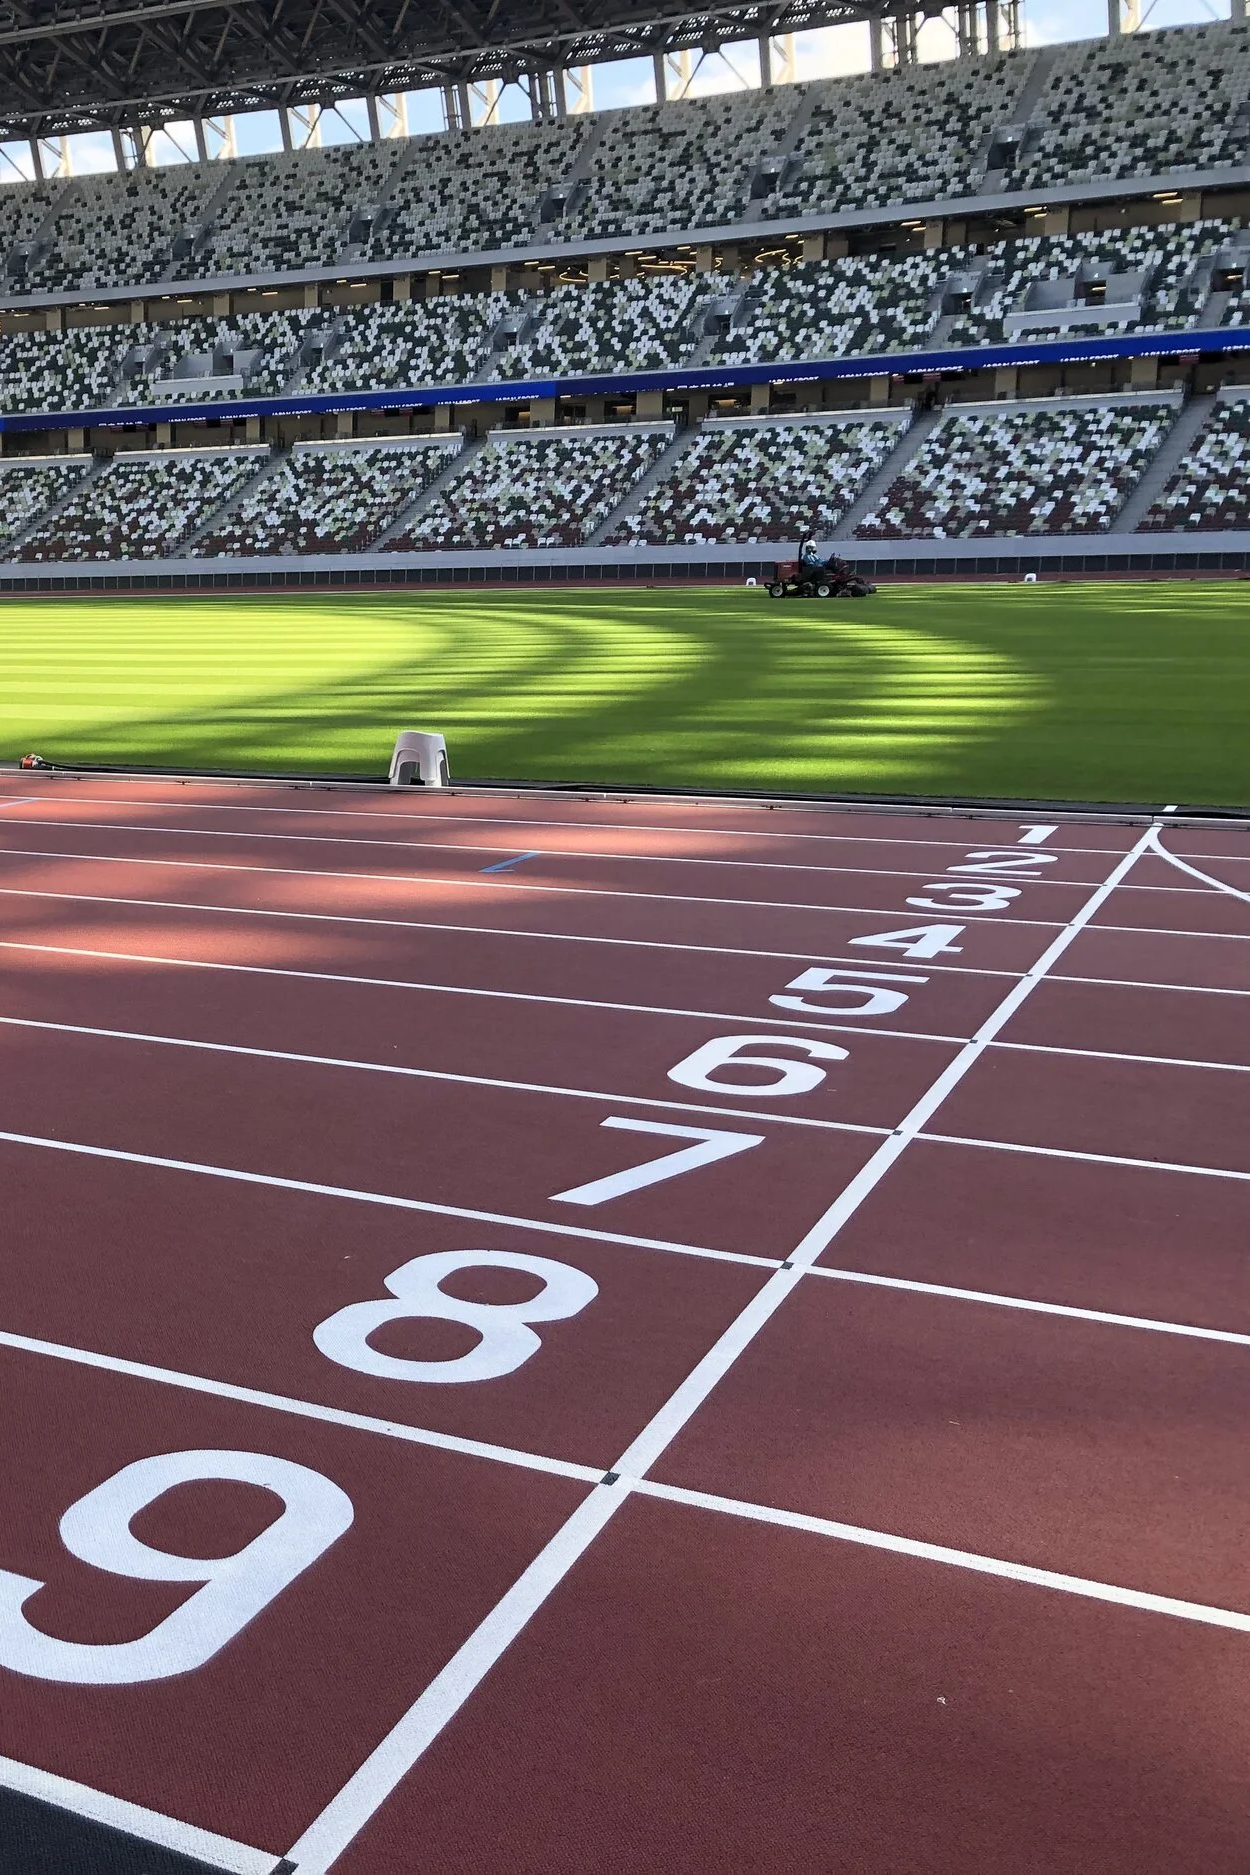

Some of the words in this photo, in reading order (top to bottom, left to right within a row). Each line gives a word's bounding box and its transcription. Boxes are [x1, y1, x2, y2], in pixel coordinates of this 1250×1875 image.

[1017, 825, 1059, 844] 1
[945, 851, 1059, 876] 2
[905, 882, 1023, 911] 3
[847, 924, 967, 959] 4
[768, 966, 930, 1016] 5
[666, 1034, 850, 1096] 6
[547, 1116, 766, 1206] 7
[312, 1249, 599, 1384] 8
